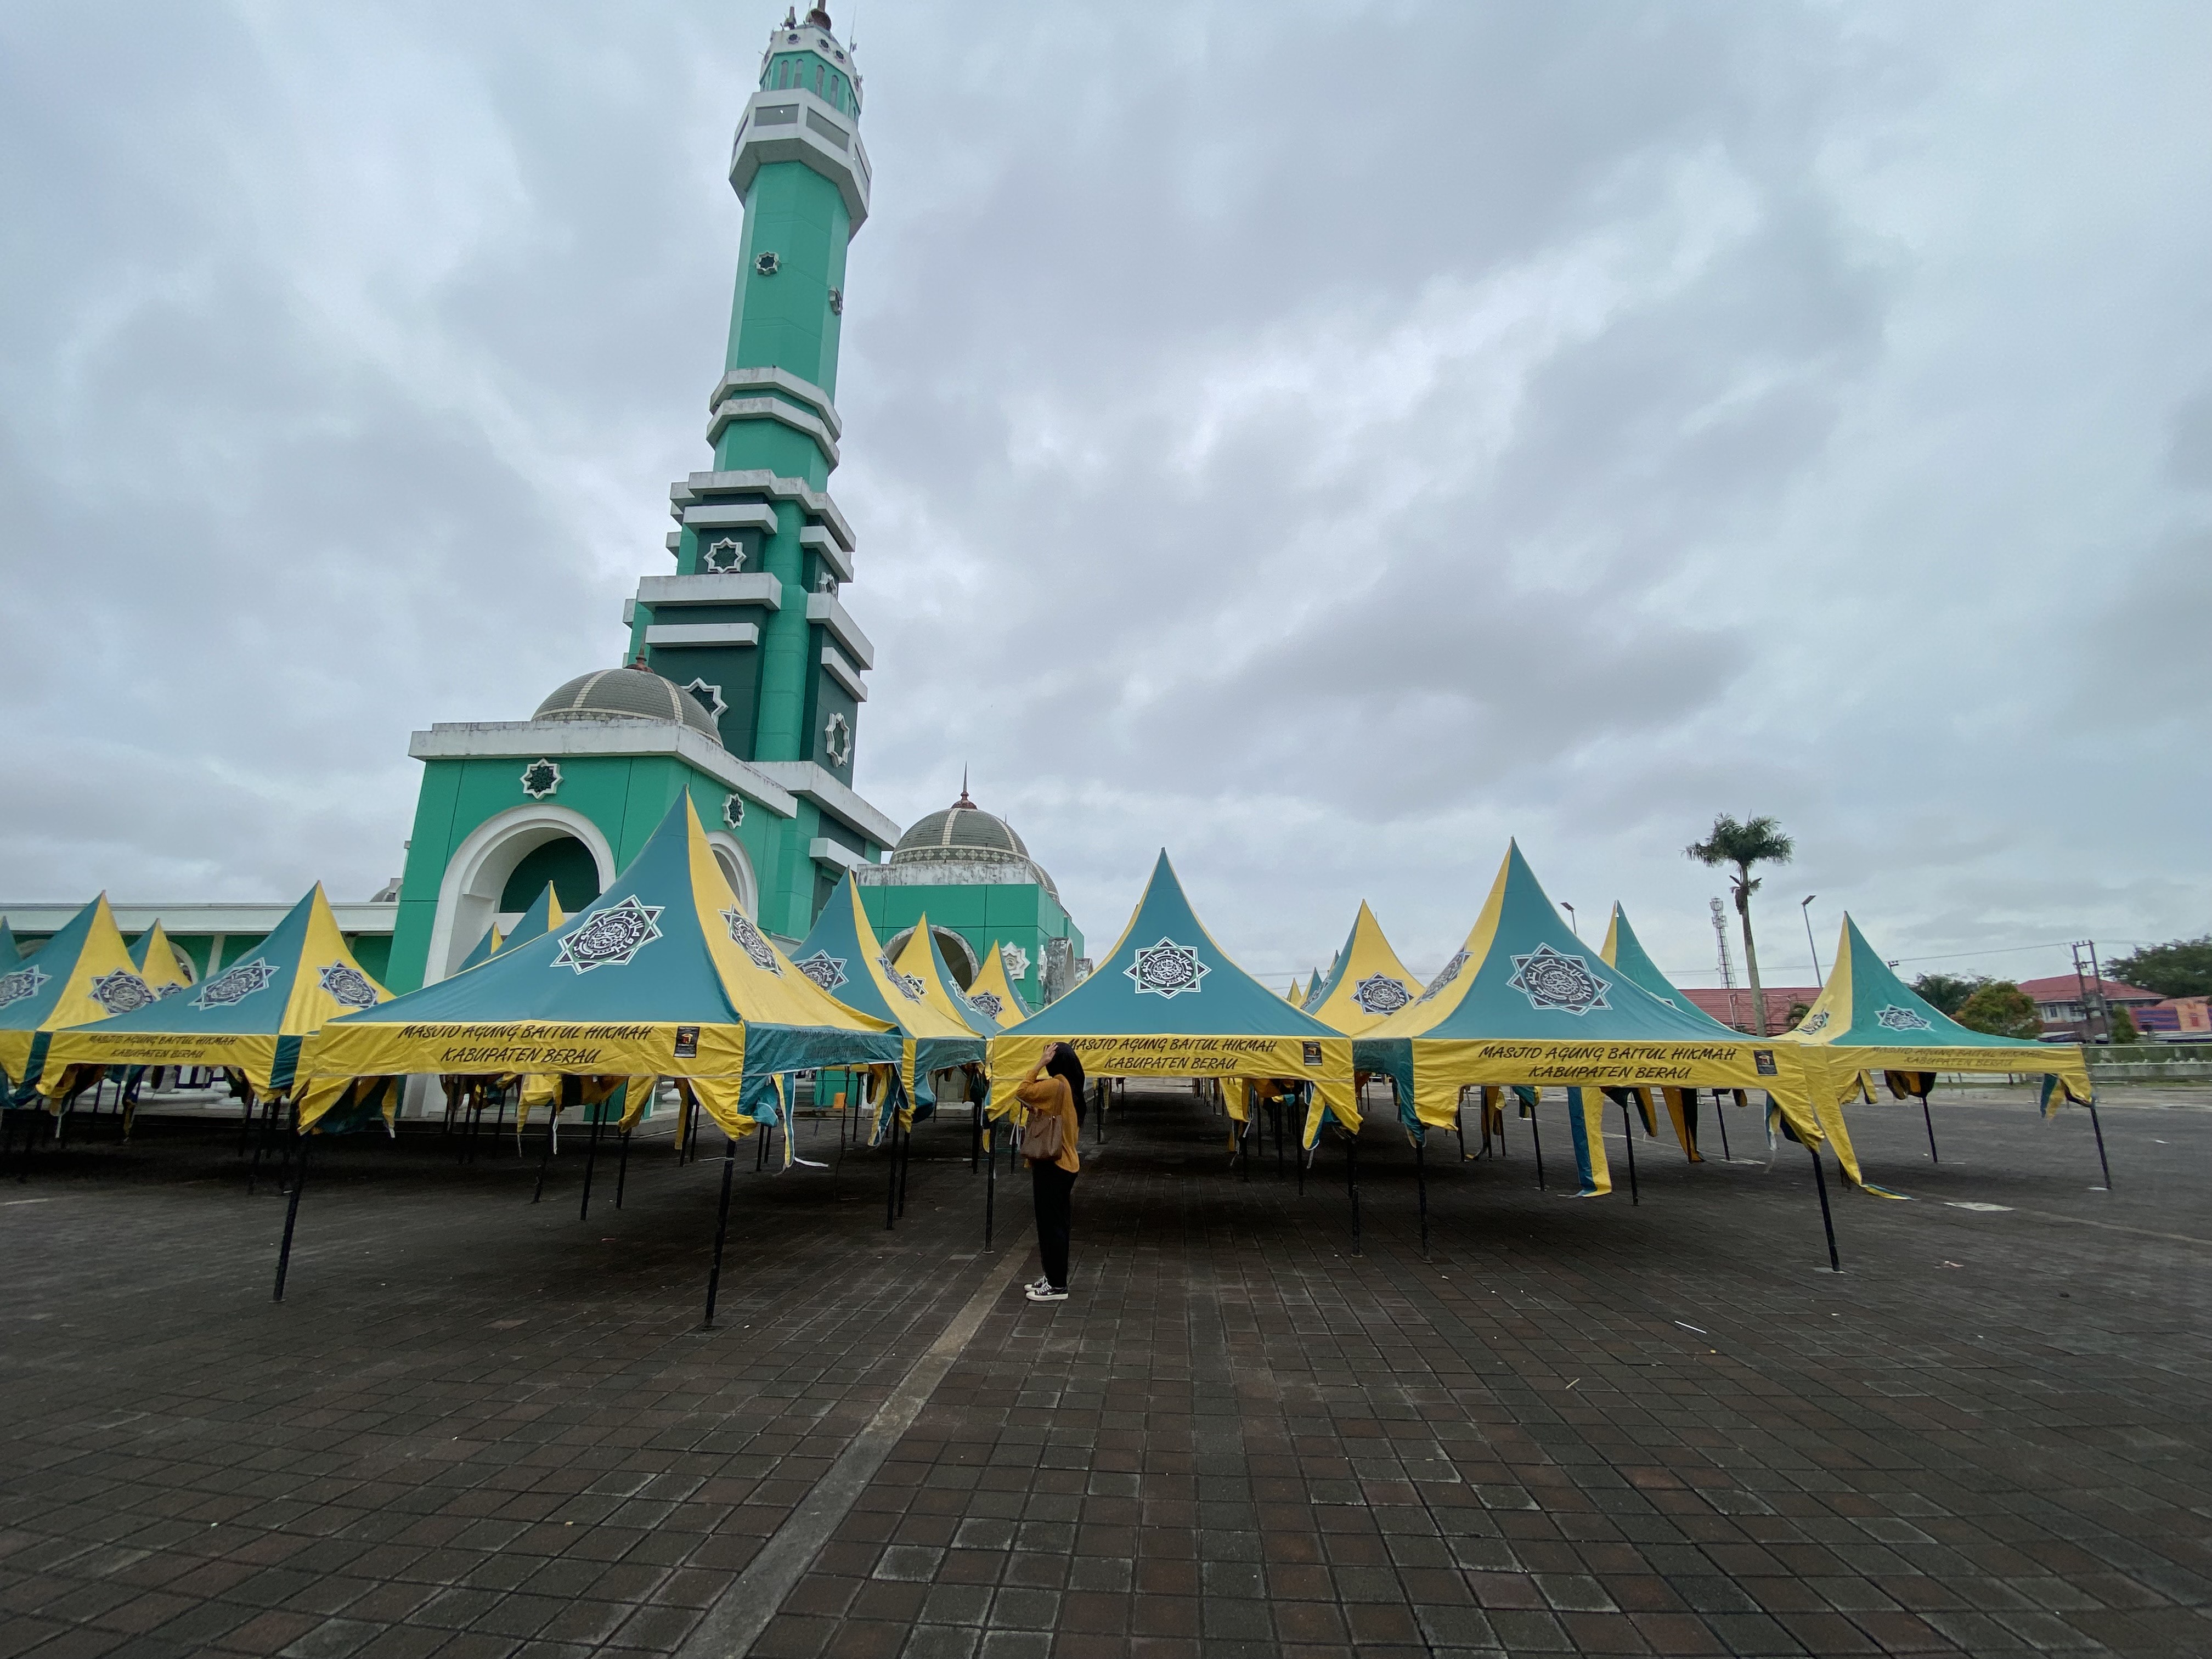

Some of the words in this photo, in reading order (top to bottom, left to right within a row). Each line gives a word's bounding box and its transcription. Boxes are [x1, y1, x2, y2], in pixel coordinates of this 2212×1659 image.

[397, 1025, 461, 1039] MASJID
[462, 1024, 518, 1041] AGUNG
[521, 1025, 583, 1039] BAITUL
[584, 1025, 654, 1040] HIKMAH
[195, 1036, 238, 1045] HIKMAH
[1068, 1038, 1117, 1050] MASJID
[1119, 1039, 1167, 1052] AGUNG
[1169, 1039, 1218, 1051] BAITUL
[1221, 1039, 1277, 1052] HIKMAH
[441, 1047, 543, 1063] KABUPATEN
[541, 1048, 601, 1064] BERAU
[1479, 1047, 1542, 1059] MASJID
[1545, 1047, 1605, 1062] AGUNG
[1607, 1048, 1667, 1060] BAITUL
[1671, 1048, 1737, 1060] HIKMAH
[1104, 1057, 1190, 1069] KABUPATEN
[1191, 1058, 1238, 1070] BERAU
[1528, 1066, 1633, 1078] KABUPATEN
[1635, 1066, 1692, 1079] BERAU
